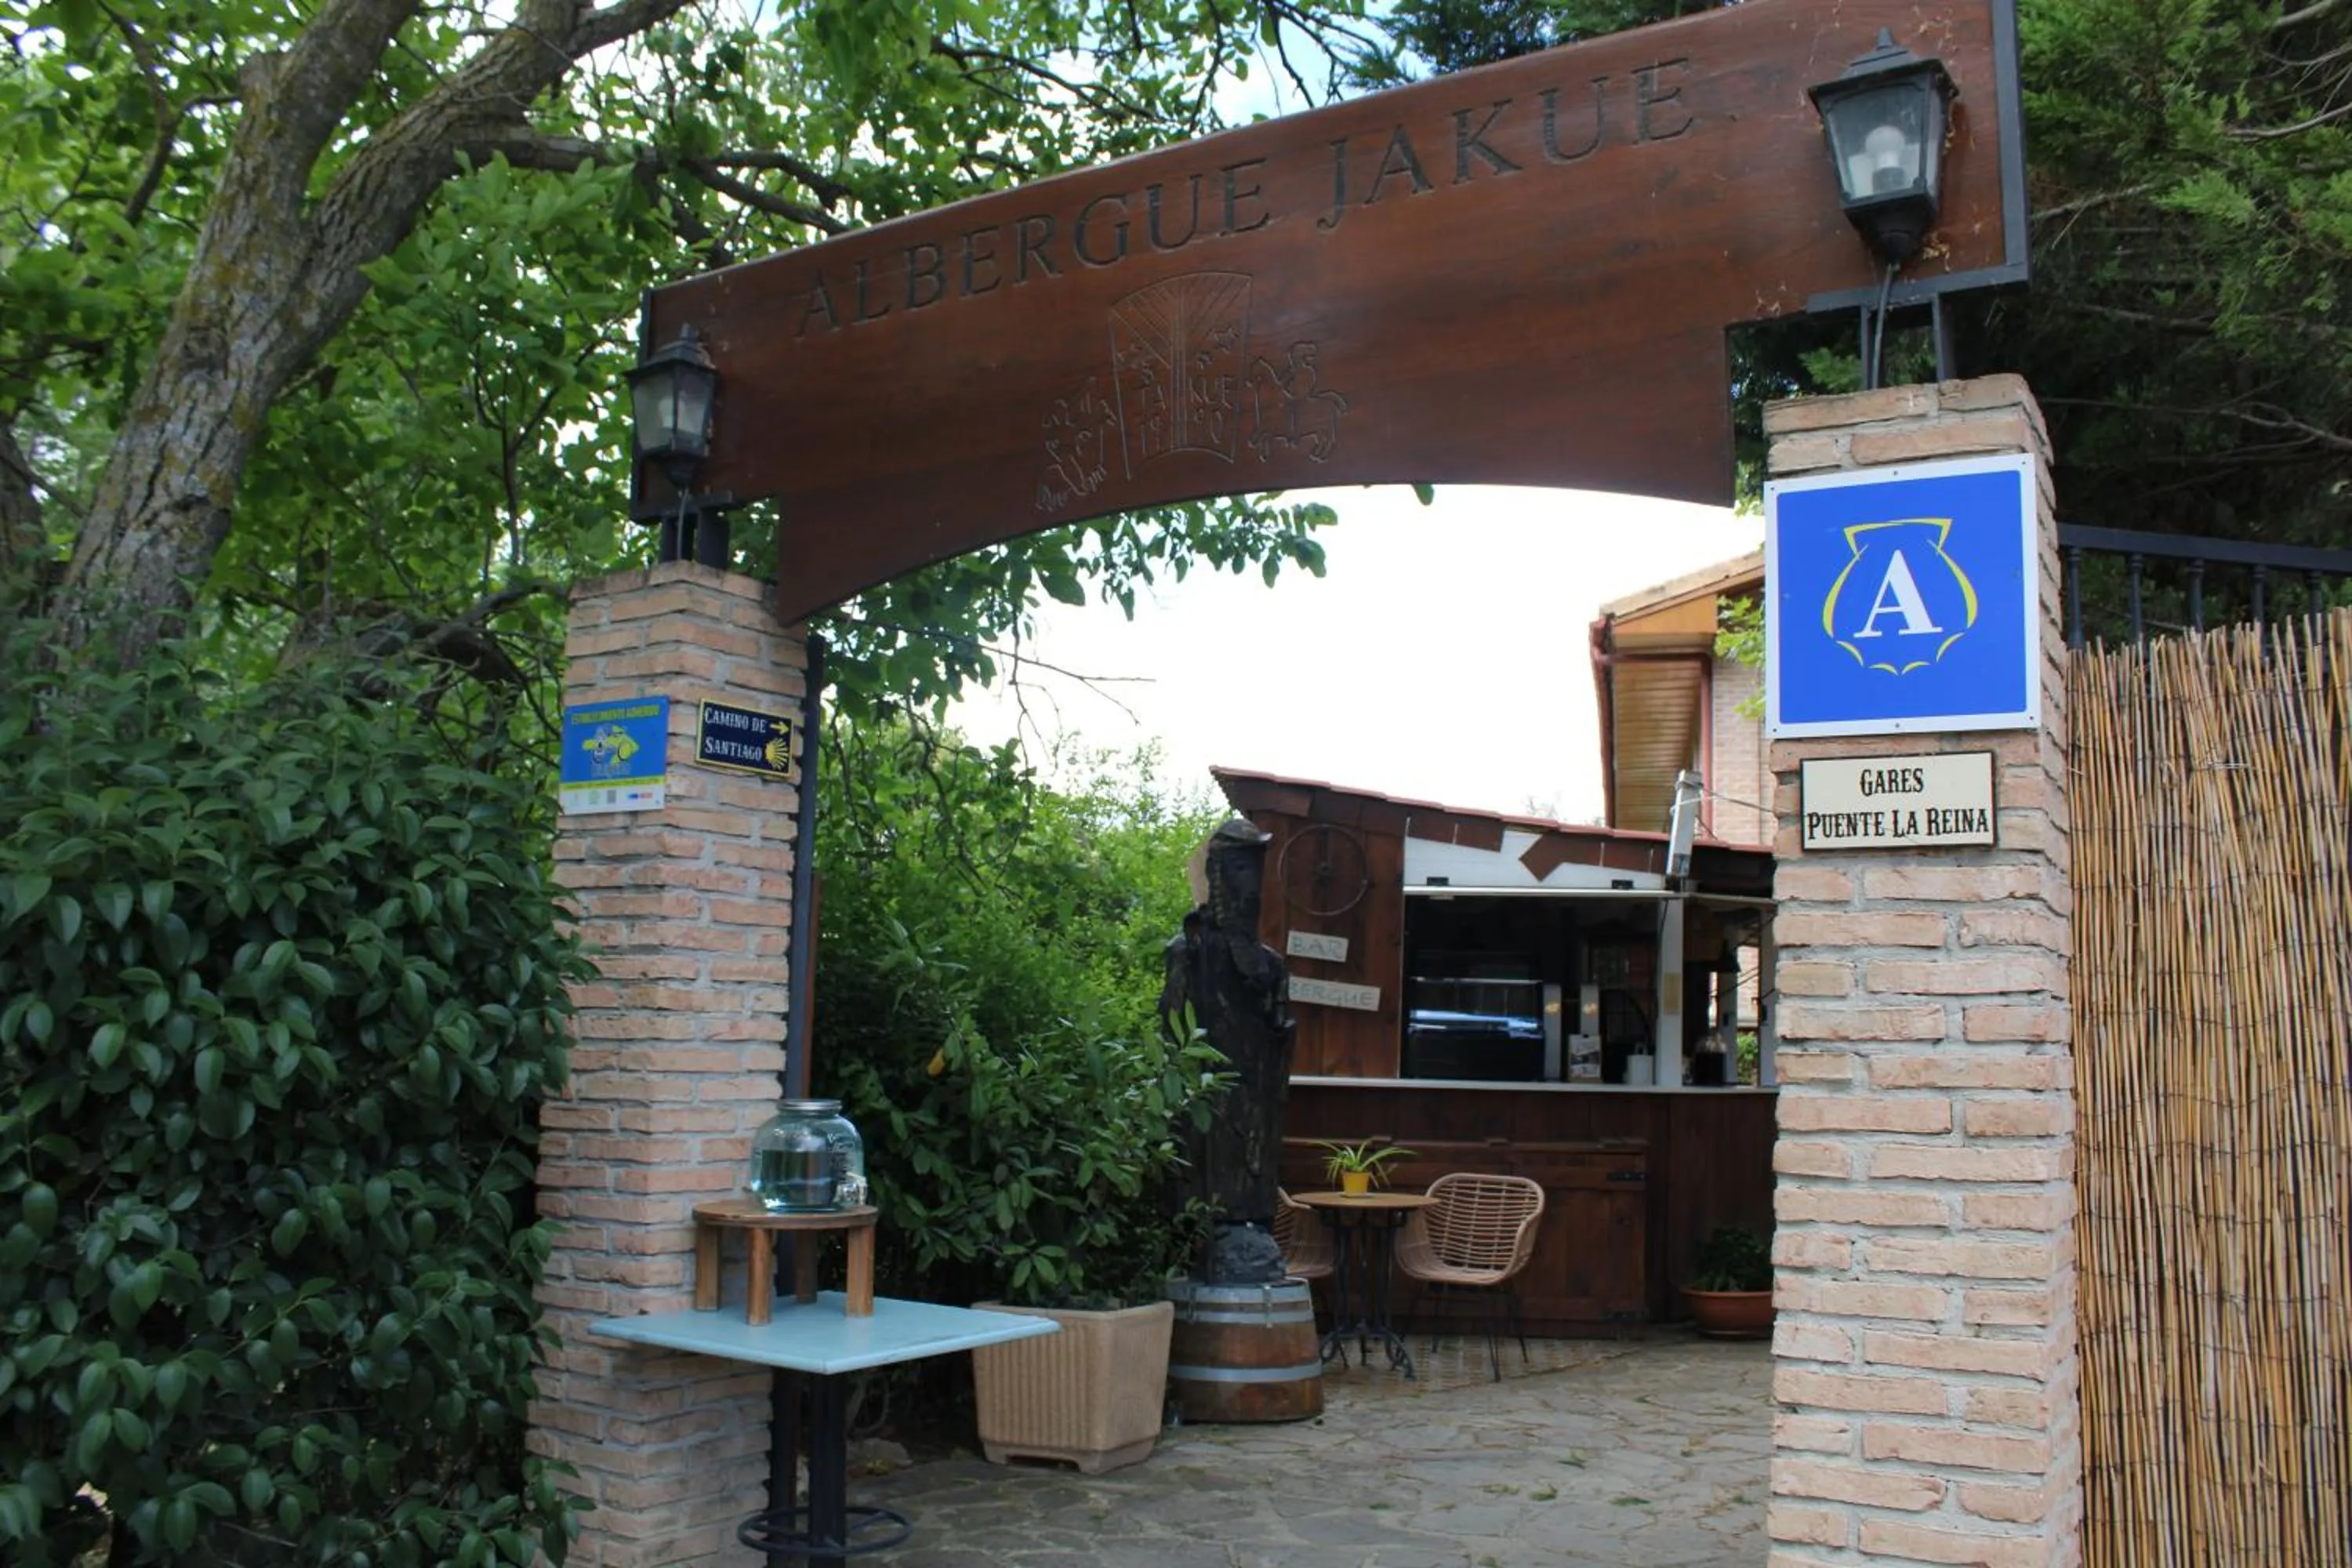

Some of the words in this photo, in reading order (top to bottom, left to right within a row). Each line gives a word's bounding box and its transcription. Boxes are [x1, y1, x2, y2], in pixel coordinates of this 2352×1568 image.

[793, 162, 1271, 339] ALBERGUE
[1316, 57, 1694, 230] JAKUE
[1853, 549, 1944, 639] A
[705, 707, 749, 730] CAMINO
[751, 717, 767, 733] DE
[705, 735, 762, 761] SANTIAGO
[1860, 768, 1925, 797] GARES
[1807, 811, 1886, 840] PUENTE
[1892, 809, 1919, 838] LA
[1926, 808, 1990, 836] REINA
[1291, 934, 1344, 960] BAR
[1290, 981, 1375, 1007] BERGUE
